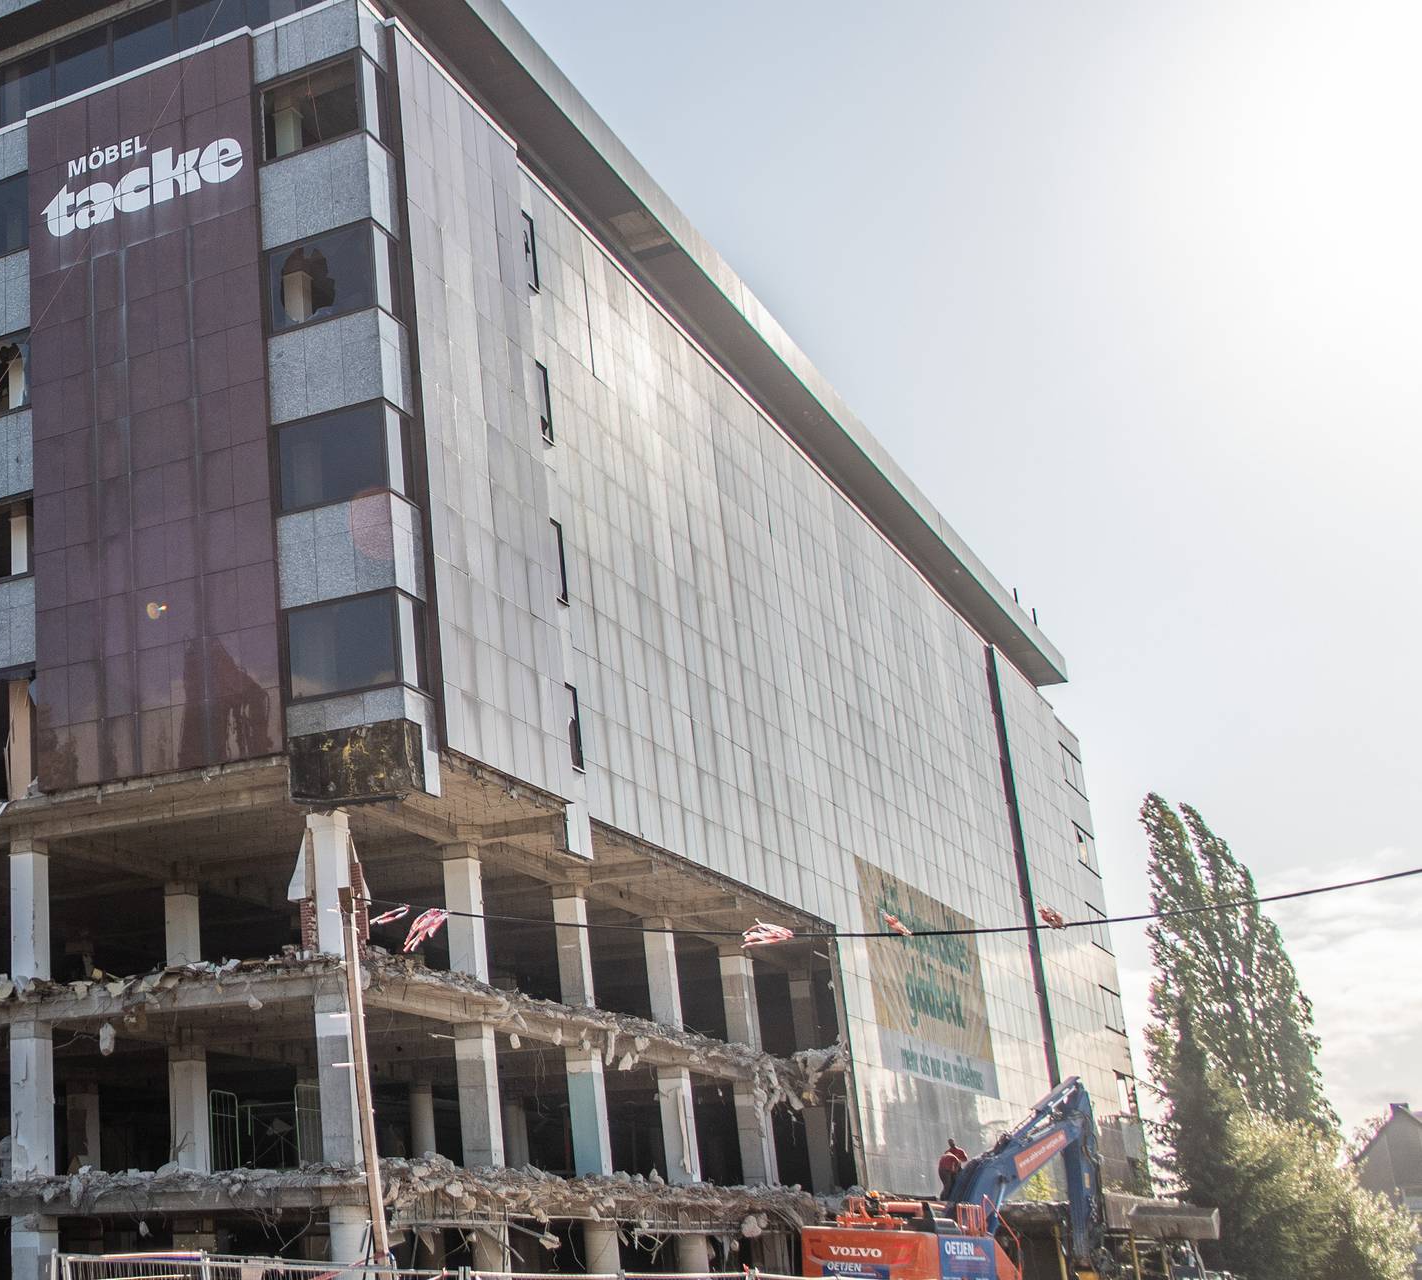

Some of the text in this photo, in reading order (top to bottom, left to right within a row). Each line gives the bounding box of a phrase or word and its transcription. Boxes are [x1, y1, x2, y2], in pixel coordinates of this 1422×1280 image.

[68, 135, 147, 178] MÖBEL
[40, 137, 243, 237] tacke
[828, 1245, 883, 1258] VOLVO
[944, 1241, 975, 1256] OETJEN
[827, 1261, 863, 1273] OETJEN
